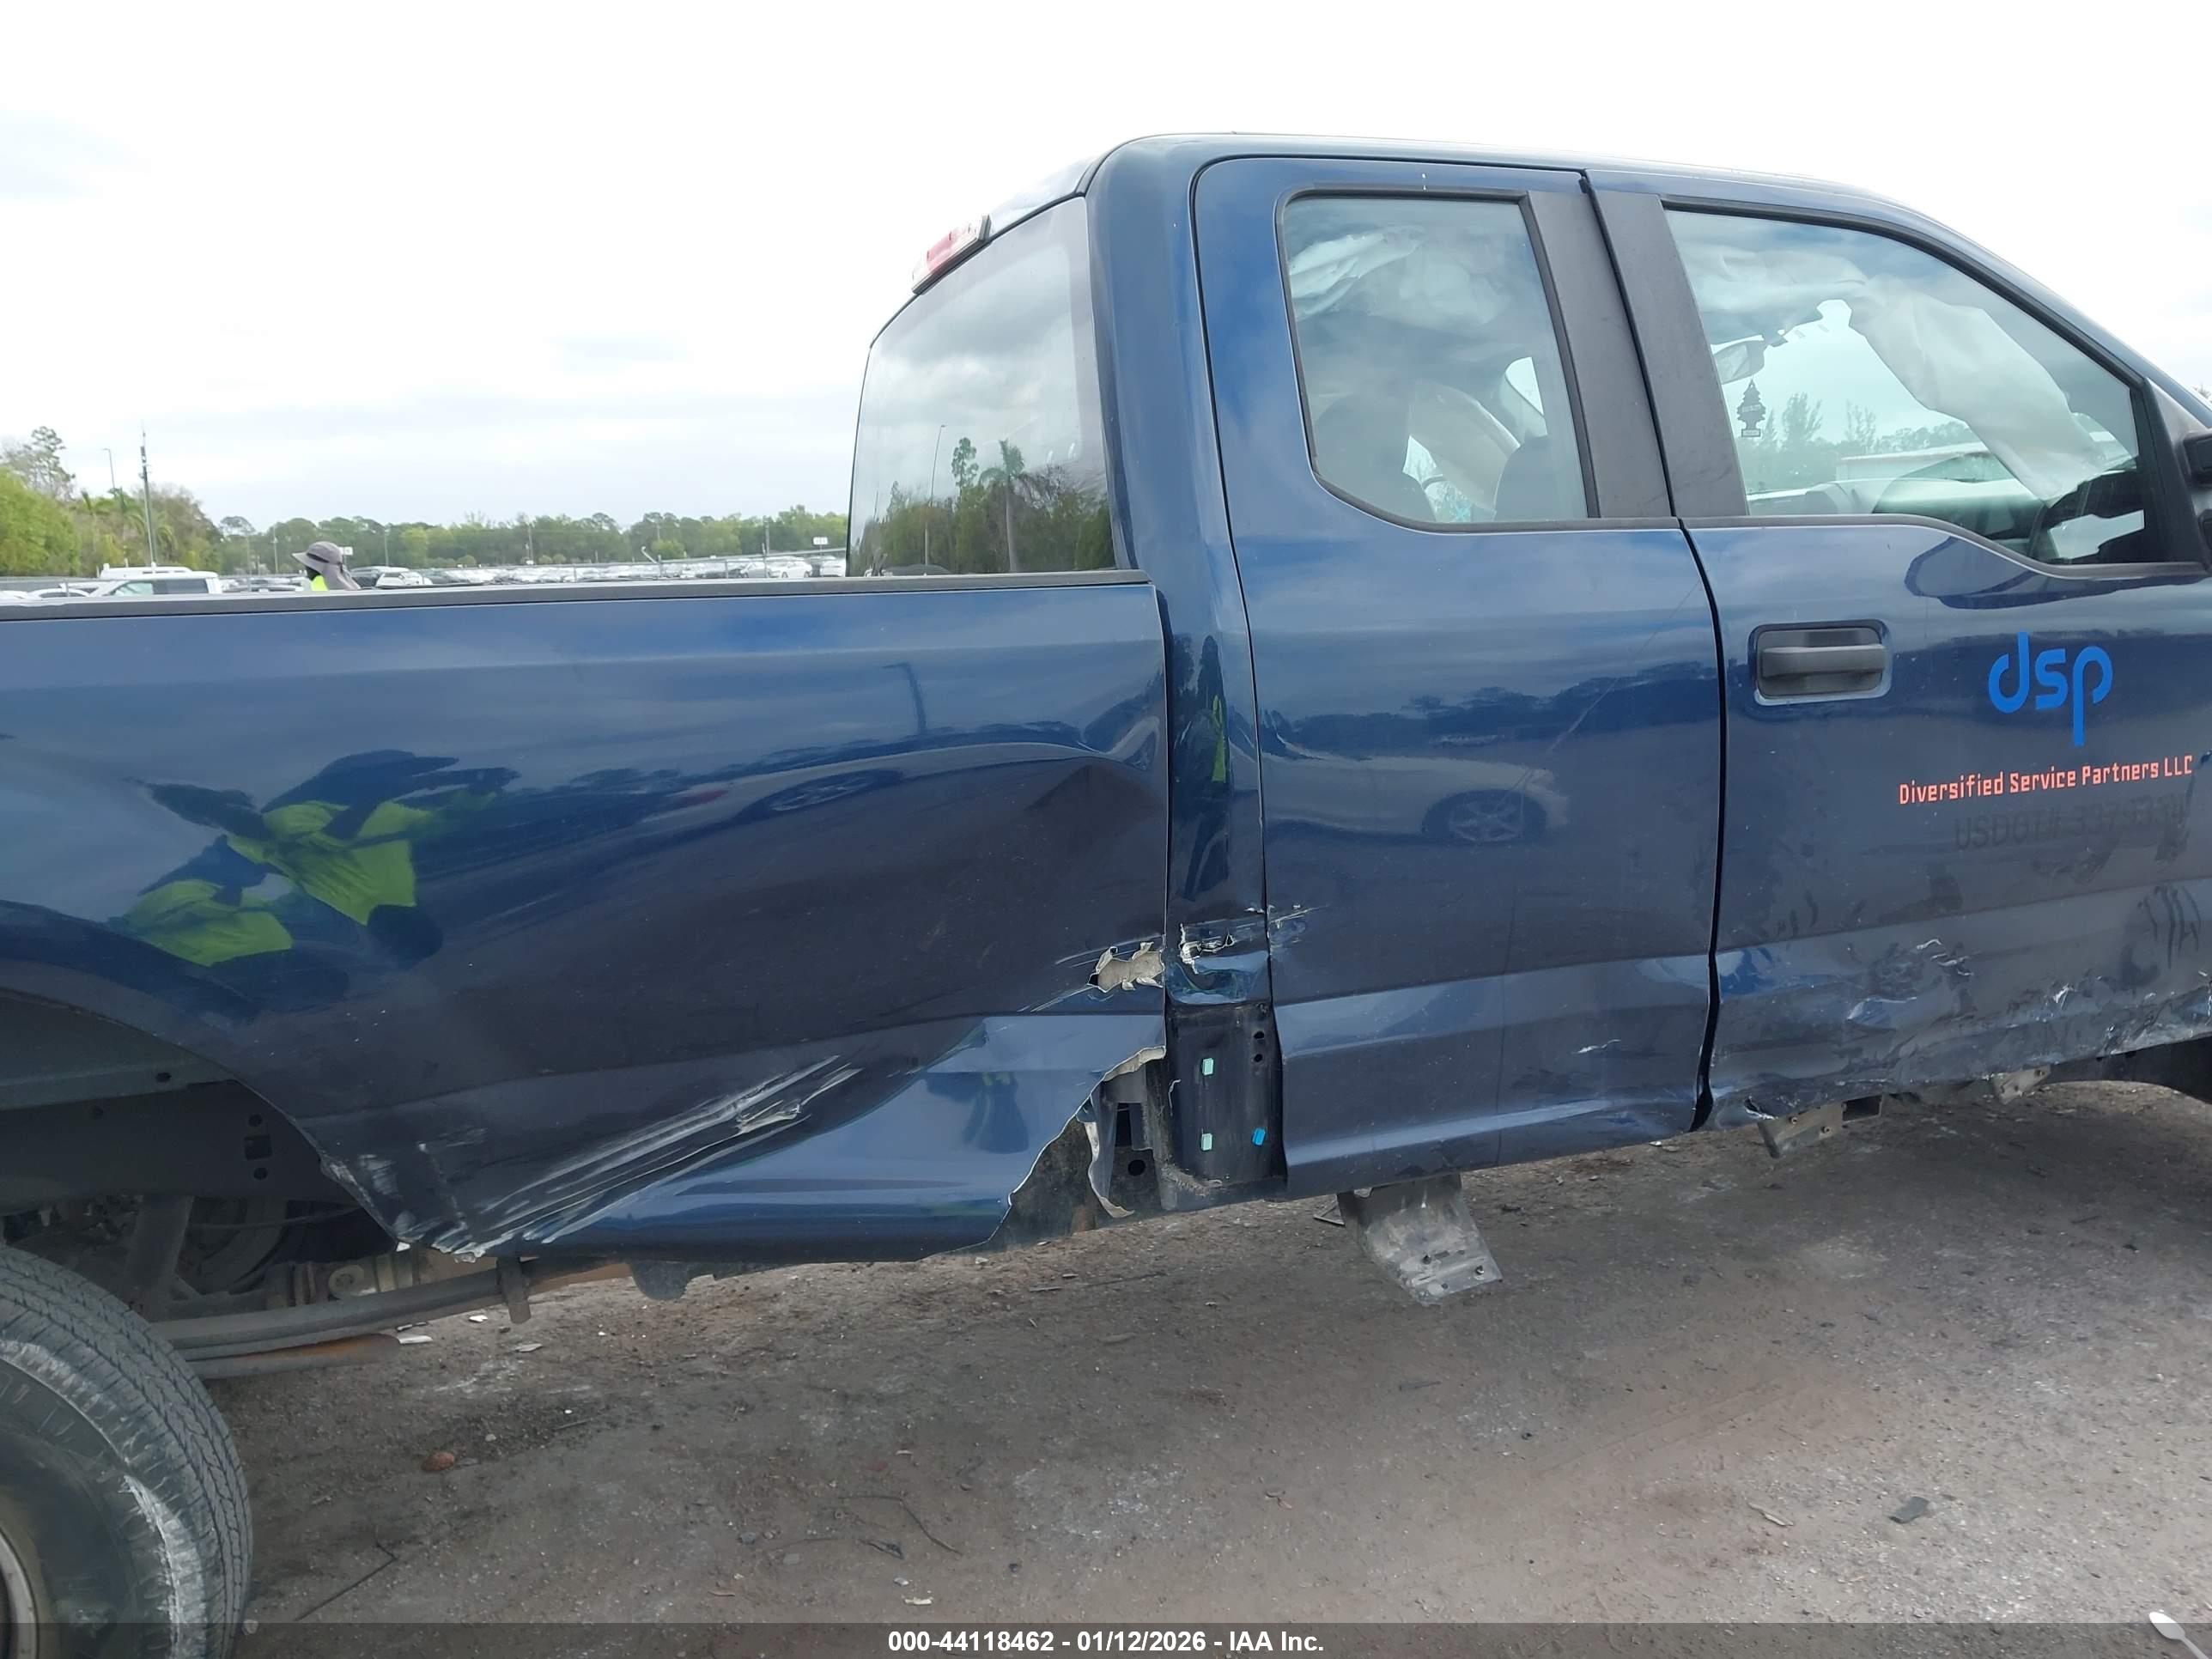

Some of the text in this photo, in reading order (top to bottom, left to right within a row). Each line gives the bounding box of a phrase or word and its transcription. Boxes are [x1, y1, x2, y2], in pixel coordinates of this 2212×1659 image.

[1988, 629, 2113, 746] dsp
[1899, 755, 2193, 805] Diversified Service Partners LLC
